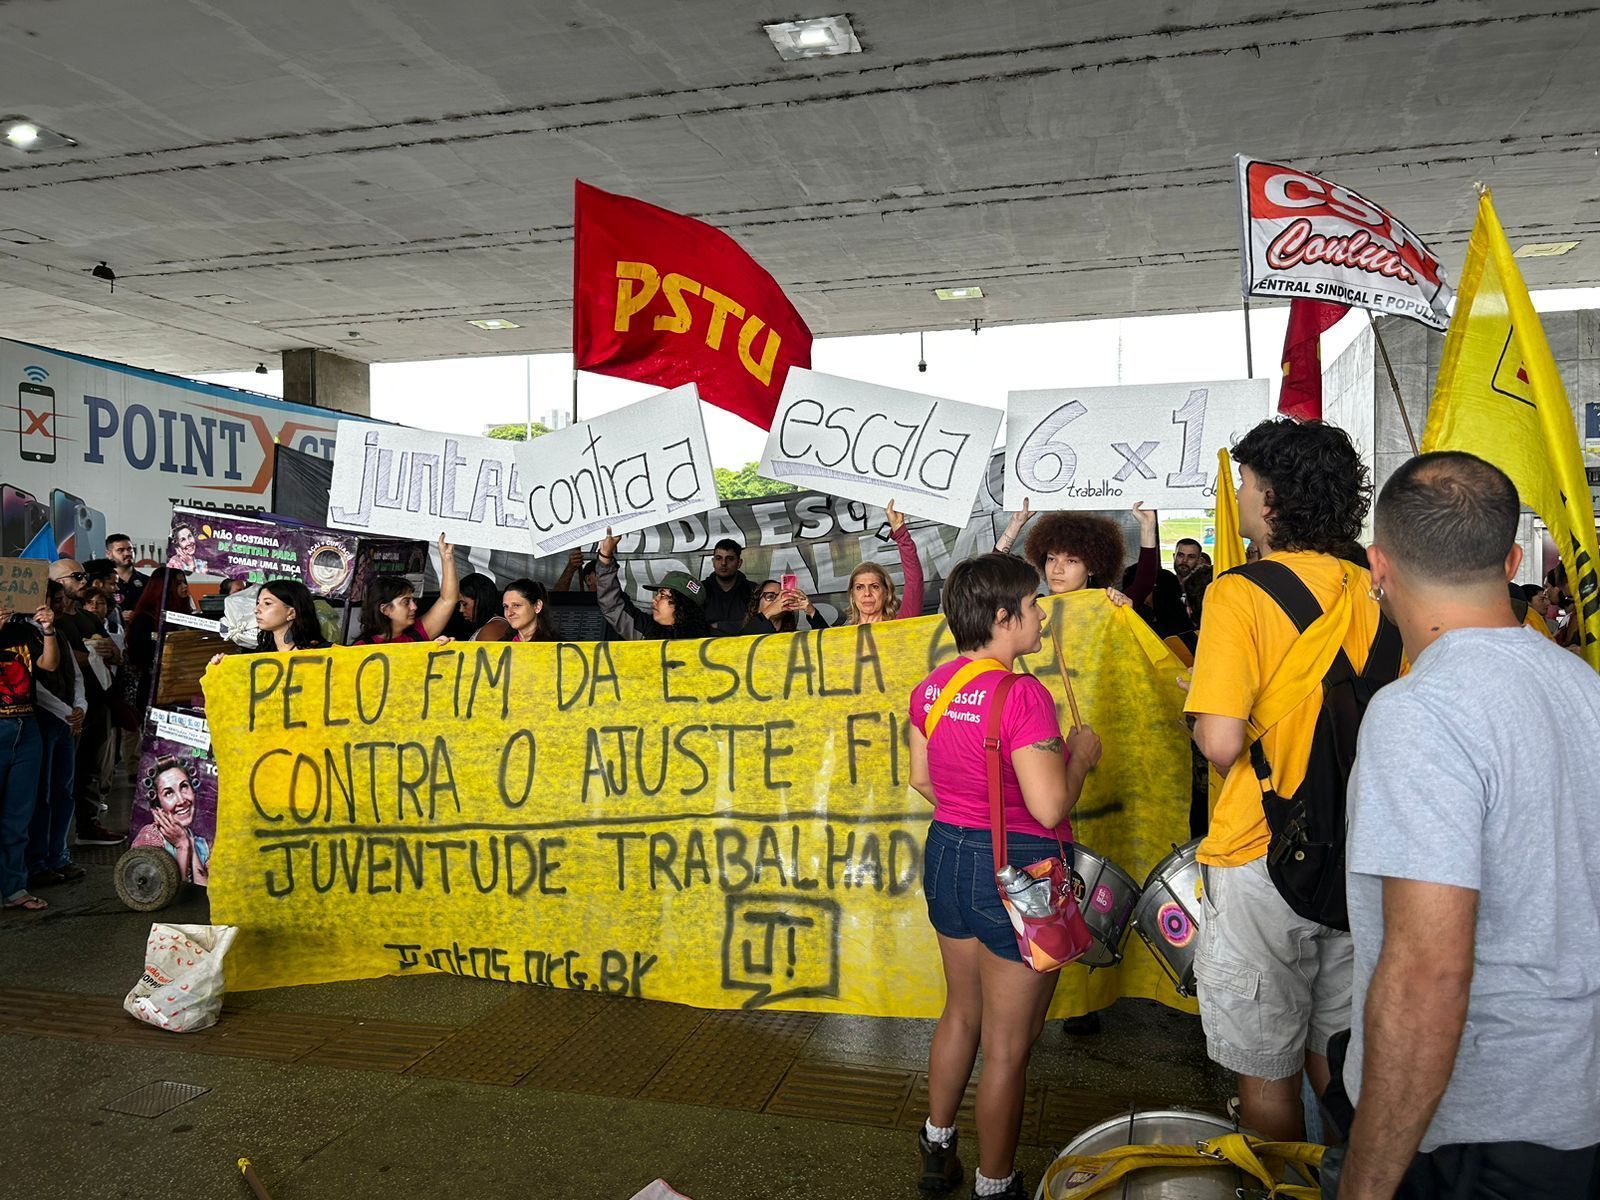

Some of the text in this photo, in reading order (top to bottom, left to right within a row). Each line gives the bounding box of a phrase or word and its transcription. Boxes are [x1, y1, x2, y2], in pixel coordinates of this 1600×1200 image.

[613, 260, 781, 387] PSTU
[1253, 279, 1443, 326] ENTRAL SINDICAL E POPULA
[83, 394, 246, 481] POINT
[529, 424, 656, 533] contra
[779, 398, 971, 492] escala
[1015, 400, 1088, 494] 6
[1166, 388, 1209, 489] 1
[1067, 478, 1123, 498] trabalho
[213, 528, 279, 548] NÃO GOSTARIA
[218, 541, 297, 561] DE SENTAR PARA
[228, 556, 301, 575] TOMAR UMA TAÇA
[249, 652, 390, 732] PELO
[422, 645, 511, 720] FIM
[557, 641, 620, 711] DA
[661, 623, 885, 704] ESCALA
[249, 736, 460, 824] CONTRA
[500, 728, 536, 810] O
[582, 720, 796, 803] AJUSTE
[259, 823, 926, 899] JUVENTUDE TRABALHAD
